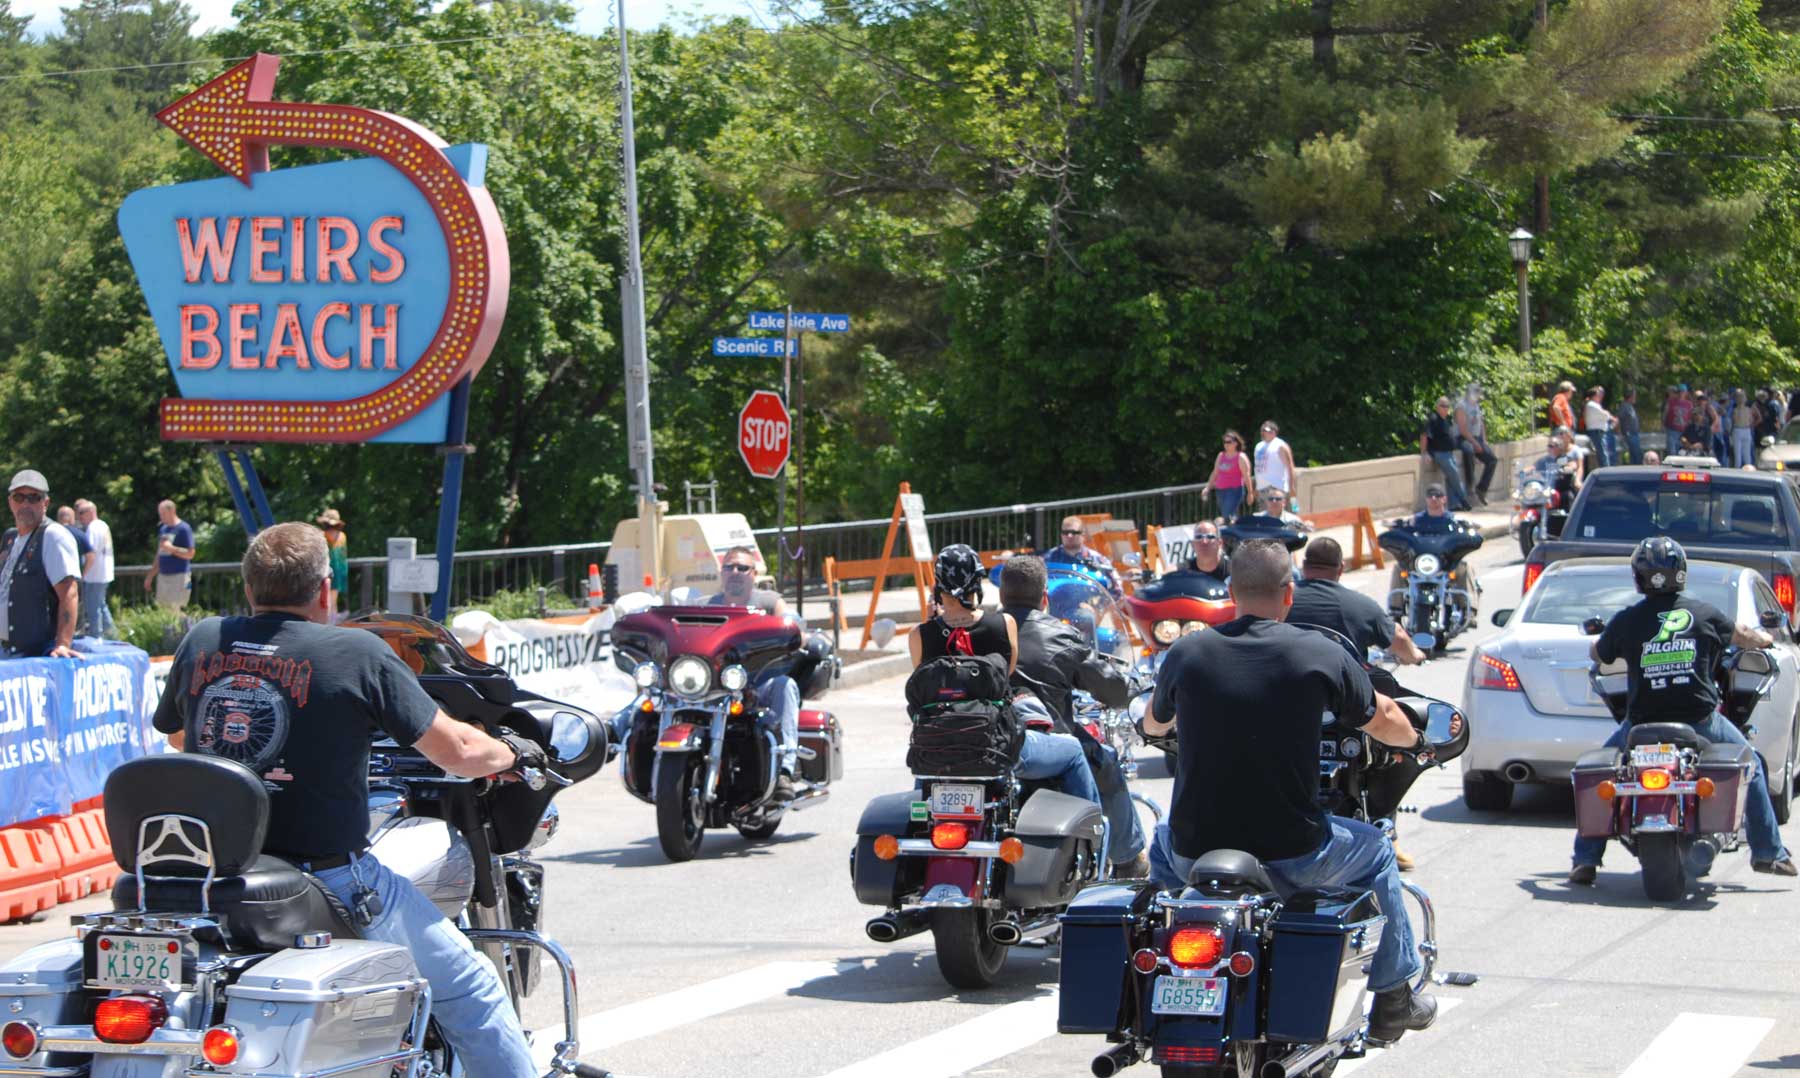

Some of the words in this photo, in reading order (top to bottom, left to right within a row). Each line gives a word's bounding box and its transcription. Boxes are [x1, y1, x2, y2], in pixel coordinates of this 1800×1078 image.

[176, 216, 406, 284] WEIRS
[821, 316, 847, 330] Ave
[178, 303, 402, 370] BEACH
[716, 340, 768, 353] Scenic
[743, 417, 787, 452] STOP
[1644, 640, 1696, 654] PILGRIM
[189, 650, 312, 709] LACONIA
[940, 793, 974, 806] 32897
[107, 954, 169, 979] K1926
[1162, 988, 1216, 1006] G8555
